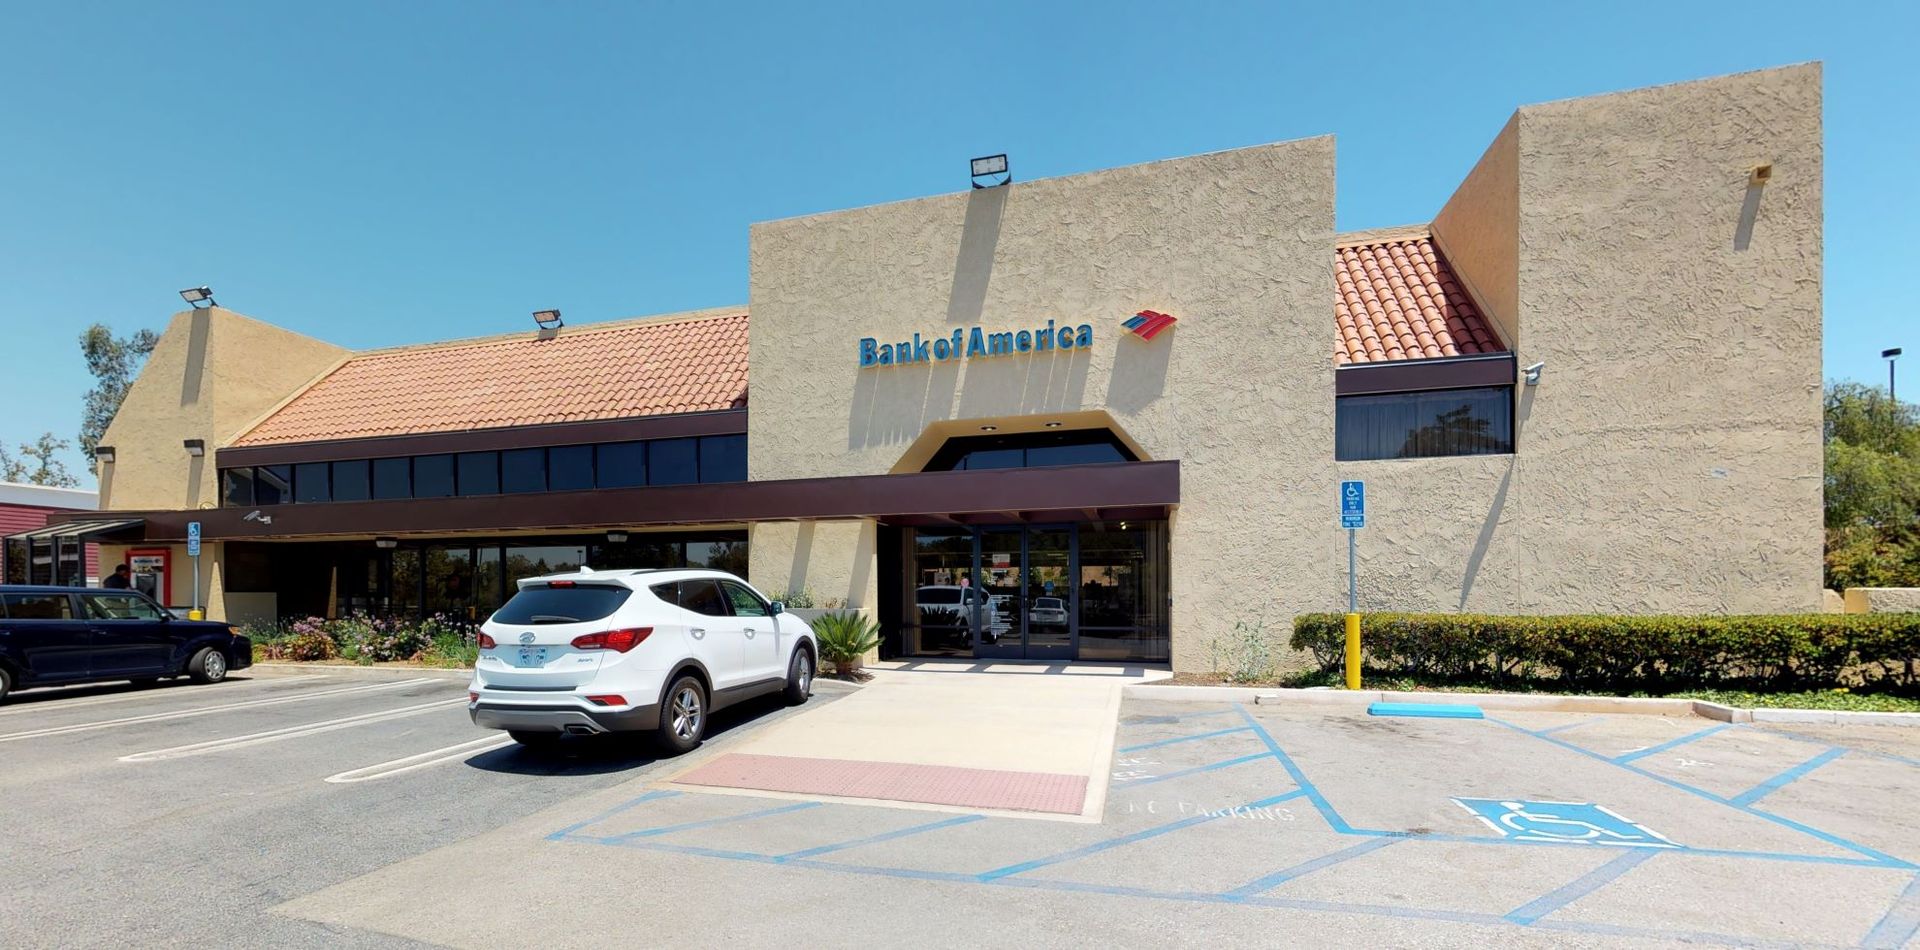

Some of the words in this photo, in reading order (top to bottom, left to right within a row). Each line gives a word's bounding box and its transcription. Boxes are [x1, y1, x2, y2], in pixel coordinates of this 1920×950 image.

[859, 332, 931, 368] Bank
[932, 328, 964, 361] of
[966, 319, 1093, 358] America
